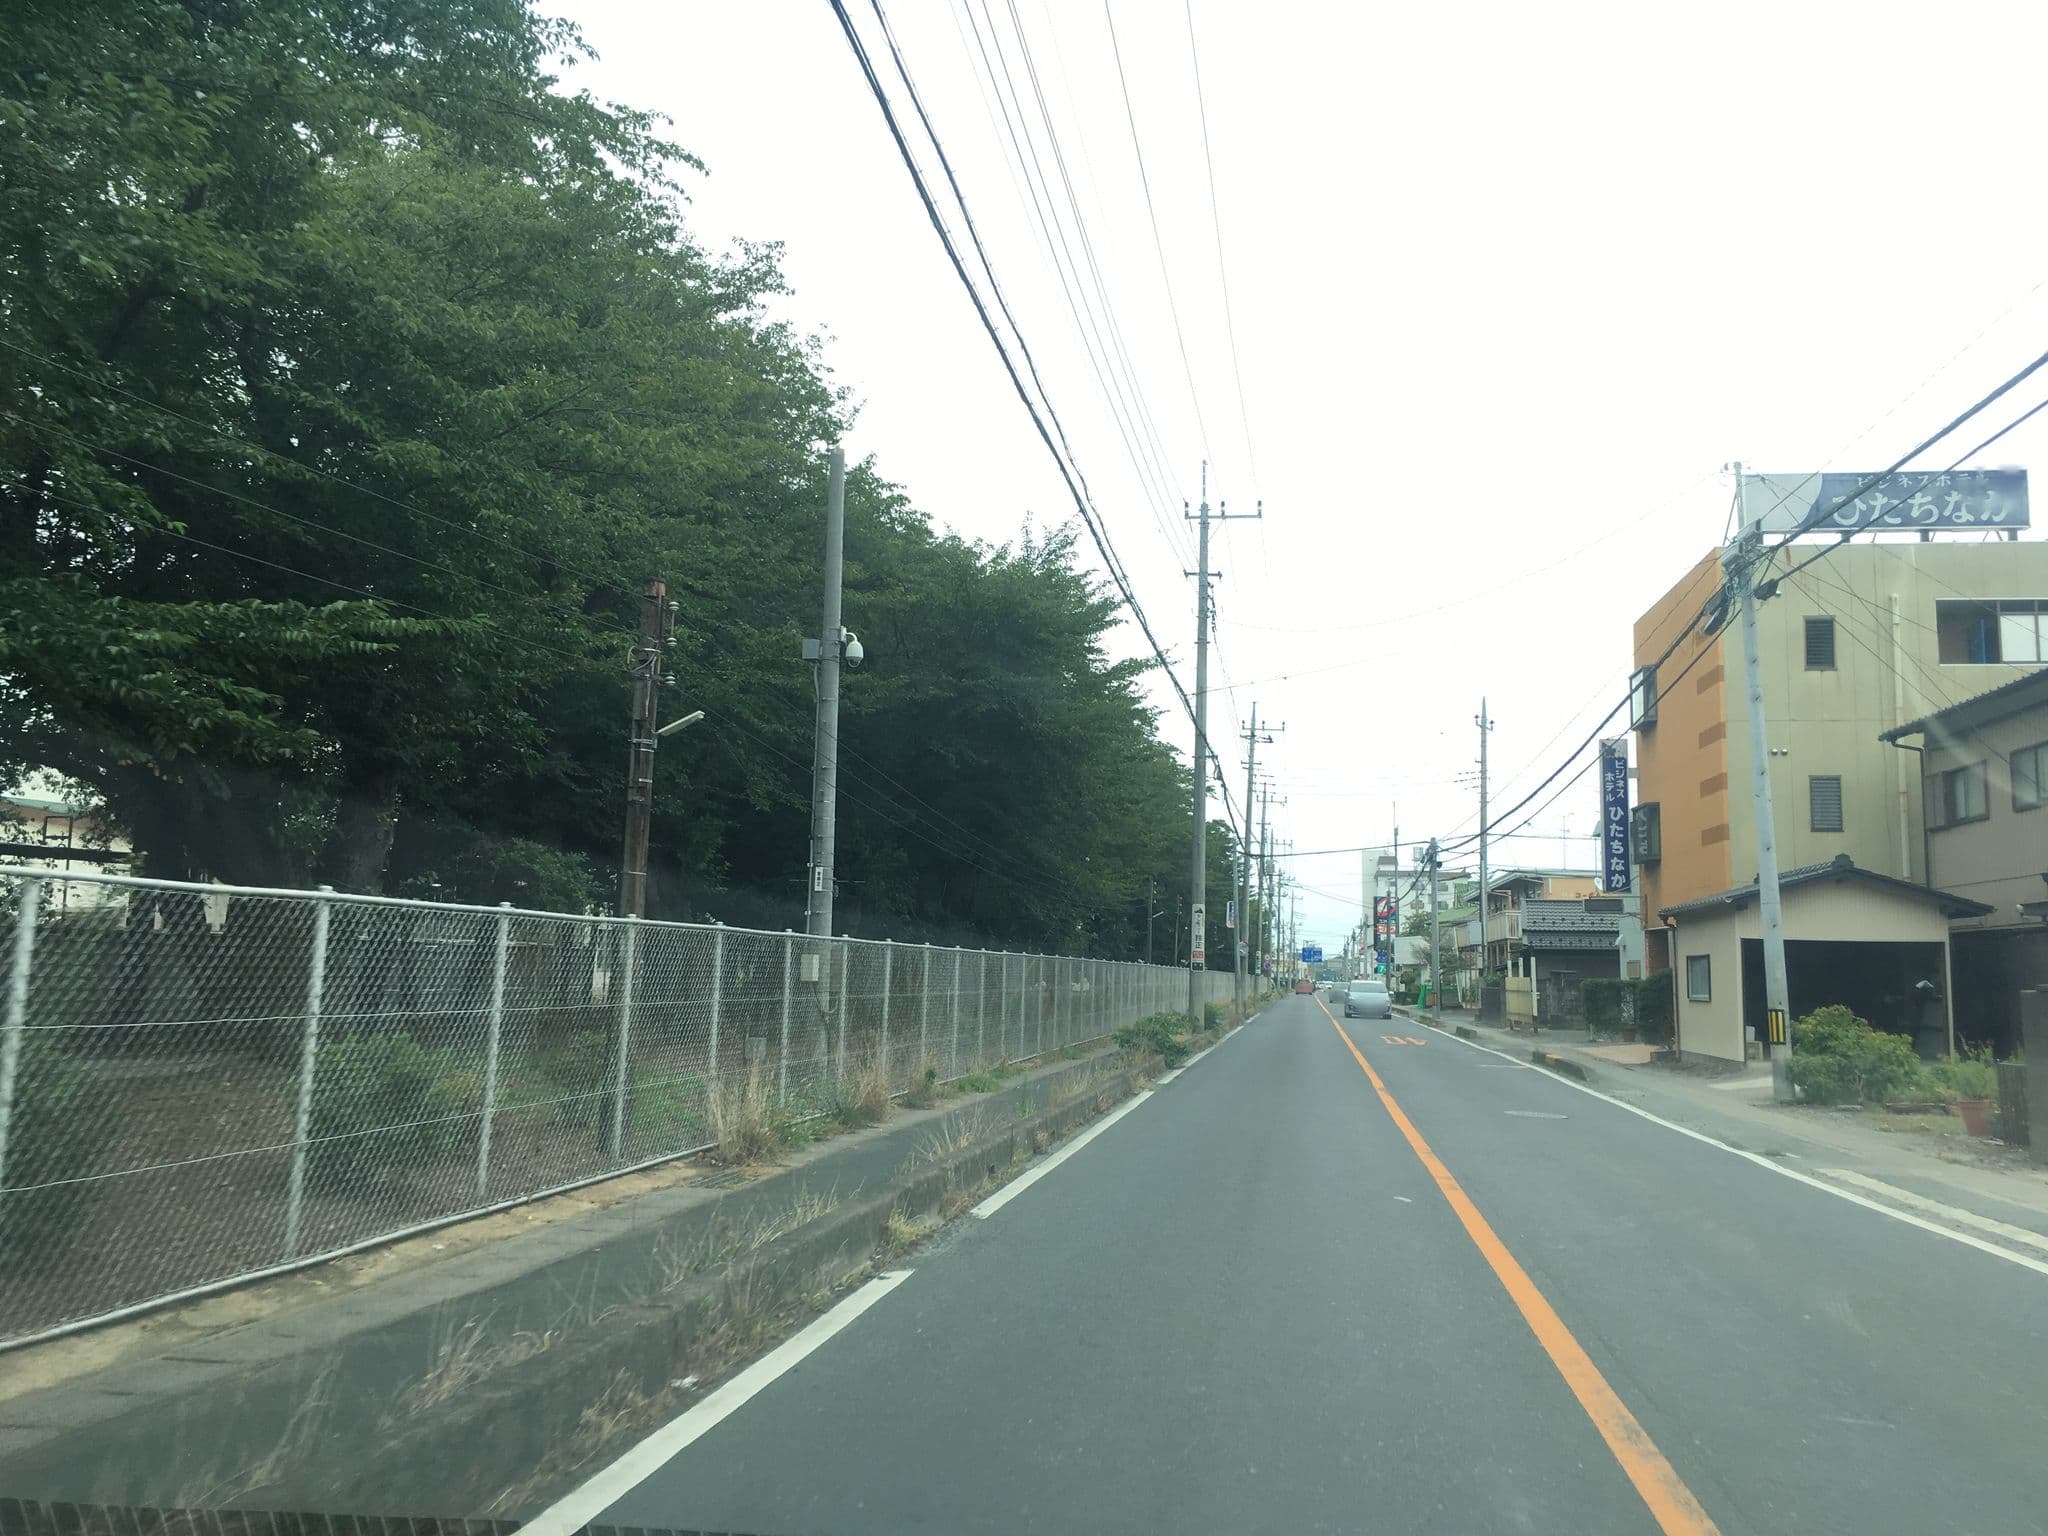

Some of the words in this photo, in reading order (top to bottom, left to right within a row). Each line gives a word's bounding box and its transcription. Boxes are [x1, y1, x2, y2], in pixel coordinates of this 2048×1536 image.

[1604, 771, 1615, 802] ホテル
[1615, 759, 1625, 799] ビジネス
[1609, 806, 1626, 889] ひたちなか
